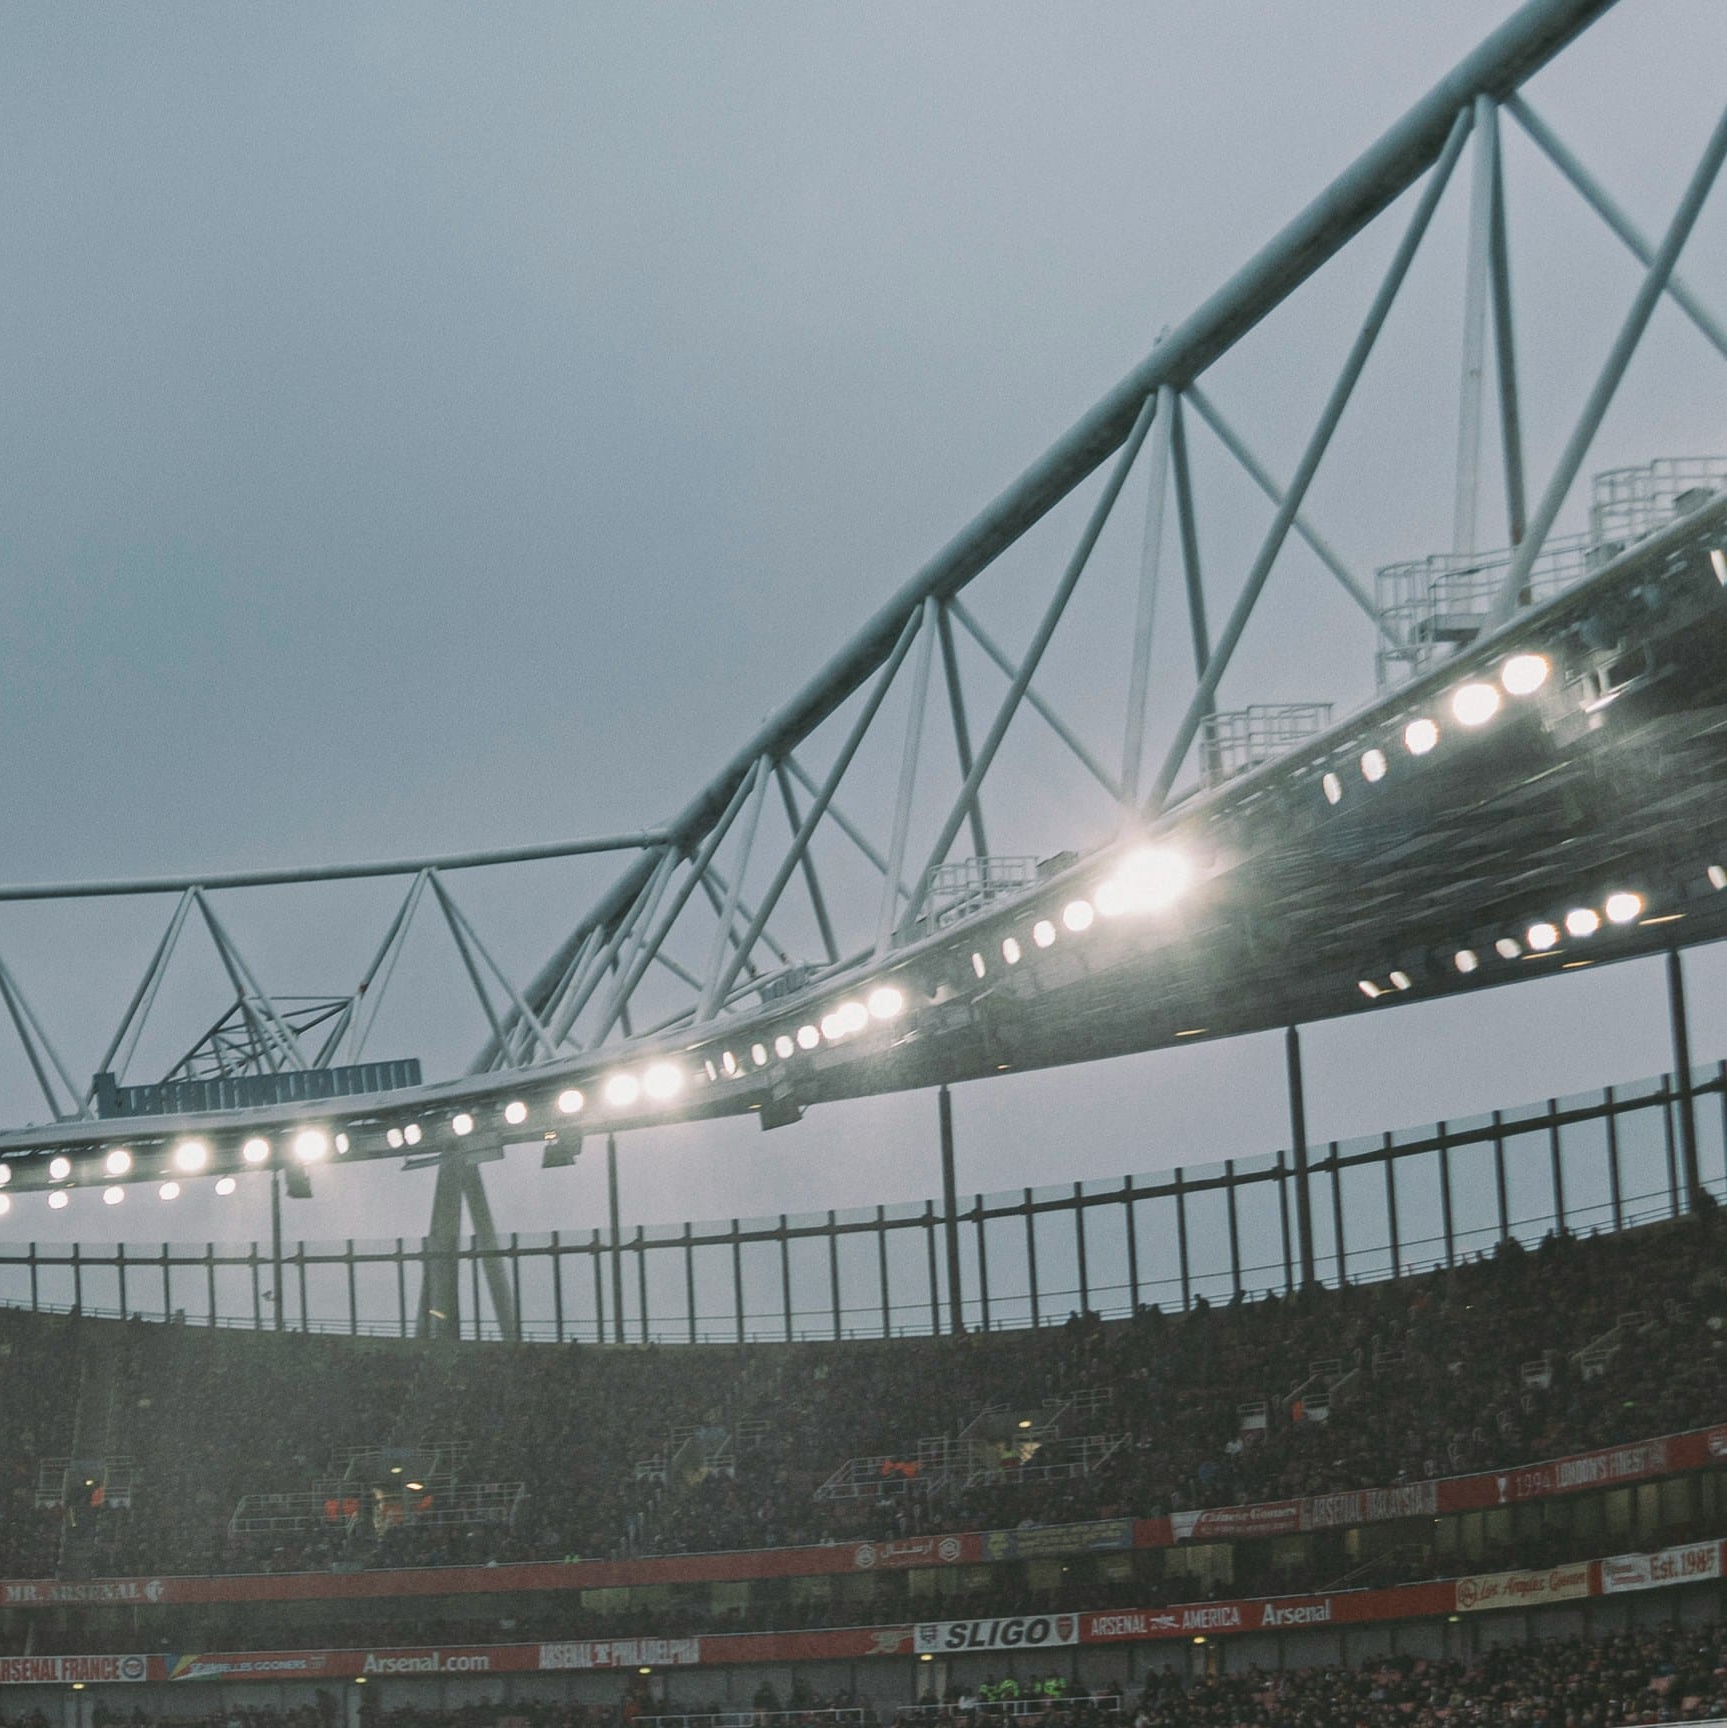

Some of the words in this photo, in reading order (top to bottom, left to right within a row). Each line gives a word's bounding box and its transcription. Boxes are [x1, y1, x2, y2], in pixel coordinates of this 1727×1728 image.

[49, 1582, 140, 1601] ARSENAL
[1091, 1614, 1148, 1636] ARSENAL
[1182, 1606, 1240, 1629] AMERICA
[1261, 1599, 1332, 1627] Arsenal
[944, 1617, 1050, 1649] SLIGO
[61, 1656, 121, 1680] FRANCE
[363, 1651, 490, 1673] Arsenal.com
